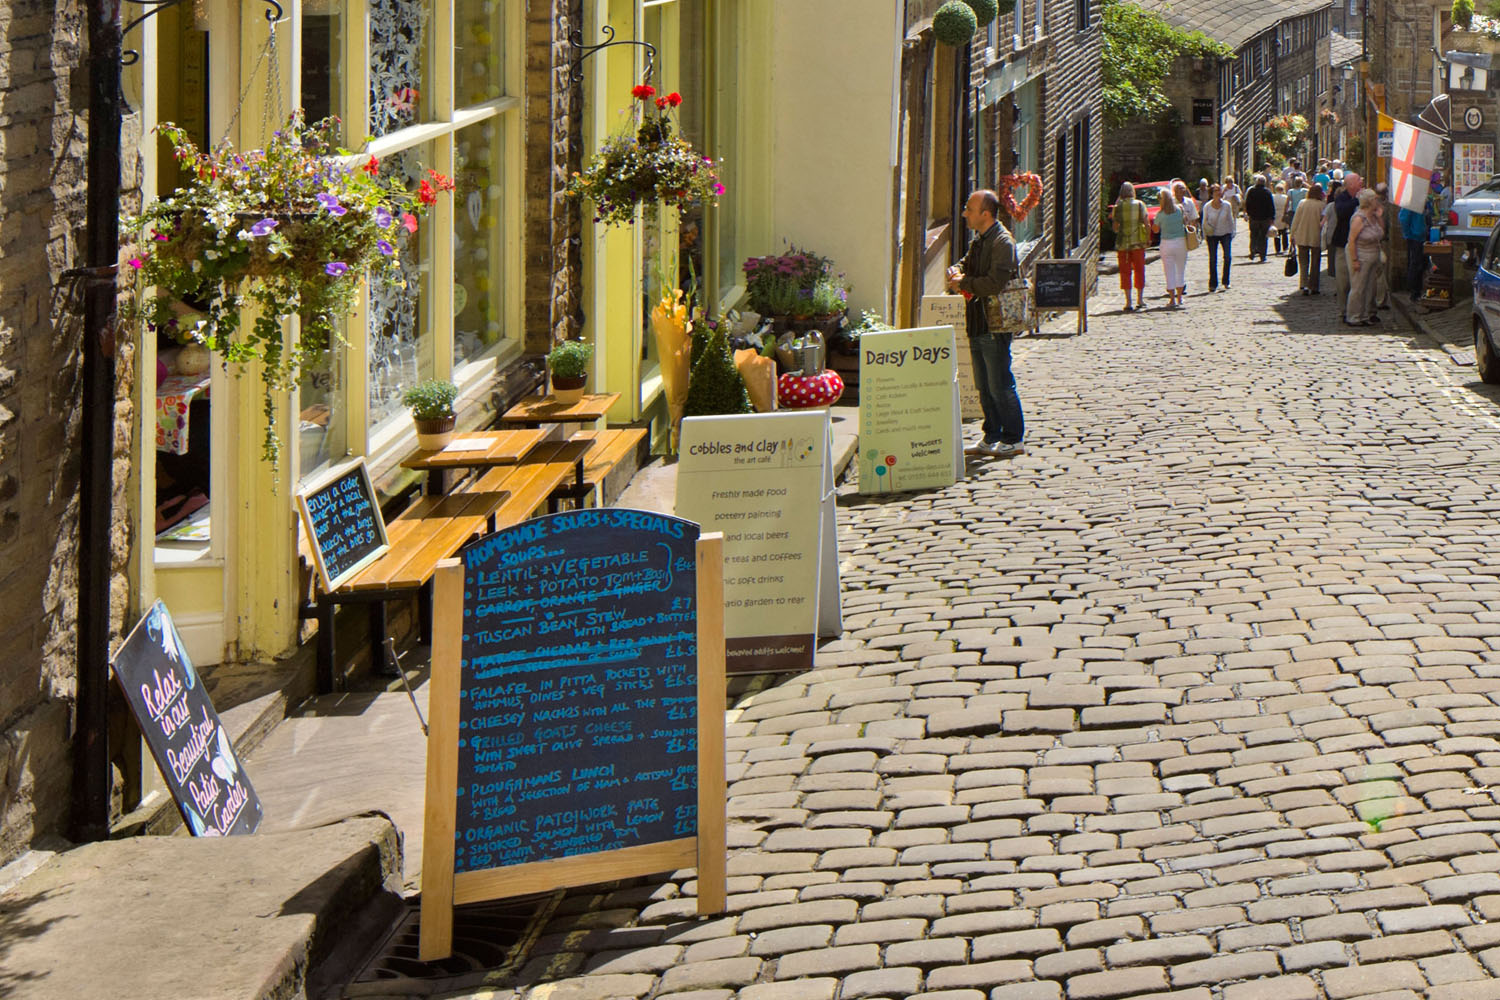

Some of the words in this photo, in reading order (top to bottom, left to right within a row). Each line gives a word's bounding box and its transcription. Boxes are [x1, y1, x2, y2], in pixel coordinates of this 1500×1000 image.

[866, 350, 907, 367] Daisy
[912, 347, 950, 364] Days
[735, 441, 754, 453] and
[734, 456, 745, 464] the
[747, 456, 756, 464] art
[332, 487, 340, 498] a
[743, 489, 765, 498] made
[715, 512, 746, 521] pottery
[747, 509, 782, 519] painting
[466, 520, 548, 570] HOMEMADE
[552, 511, 600, 534] SOUPS
[610, 510, 685, 539] SPECIALS
[726, 532, 742, 541] and
[744, 530, 765, 541] local
[766, 530, 790, 540] beers
[732, 555, 751, 563] teas
[752, 553, 768, 562] and
[769, 552, 803, 562] coffees
[478, 567, 539, 586] LENTIL
[551, 550, 649, 576] VEGETABLE
[477, 585, 520, 601] LEEK
[539, 575, 599, 596] POTATO
[738, 576, 757, 585] soft
[758, 575, 785, 584] drinks
[672, 597, 692, 610] £7
[724, 599, 742, 608] atio
[744, 597, 775, 608] garden
[776, 595, 789, 605] to
[788, 596, 807, 605] rear
[474, 623, 532, 645] TUSCAN
[537, 616, 578, 635] BEAN
[585, 605, 626, 625] STEW
[574, 625, 605, 638] WITH
[540, 679, 553, 691] IN
[560, 674, 596, 691] PITTA
[605, 667, 651, 681] POCKETS
[657, 664, 686, 676] WITH
[141, 668, 182, 719] Relax
[582, 684, 605, 699] VEG
[634, 698, 656, 709] THE
[160, 715, 176, 736] in
[172, 690, 191, 726] our
[166, 704, 215, 784] Beautiful
[471, 732, 524, 752] GRILLED
[534, 725, 577, 744] GOATS
[584, 720, 632, 734] CHEESE
[572, 763, 615, 781] LUNCH
[188, 772, 220, 815] Patio
[213, 780, 248, 834] Garden
[465, 820, 529, 843] ORGANIC
[469, 836, 521, 855] SMOKED
